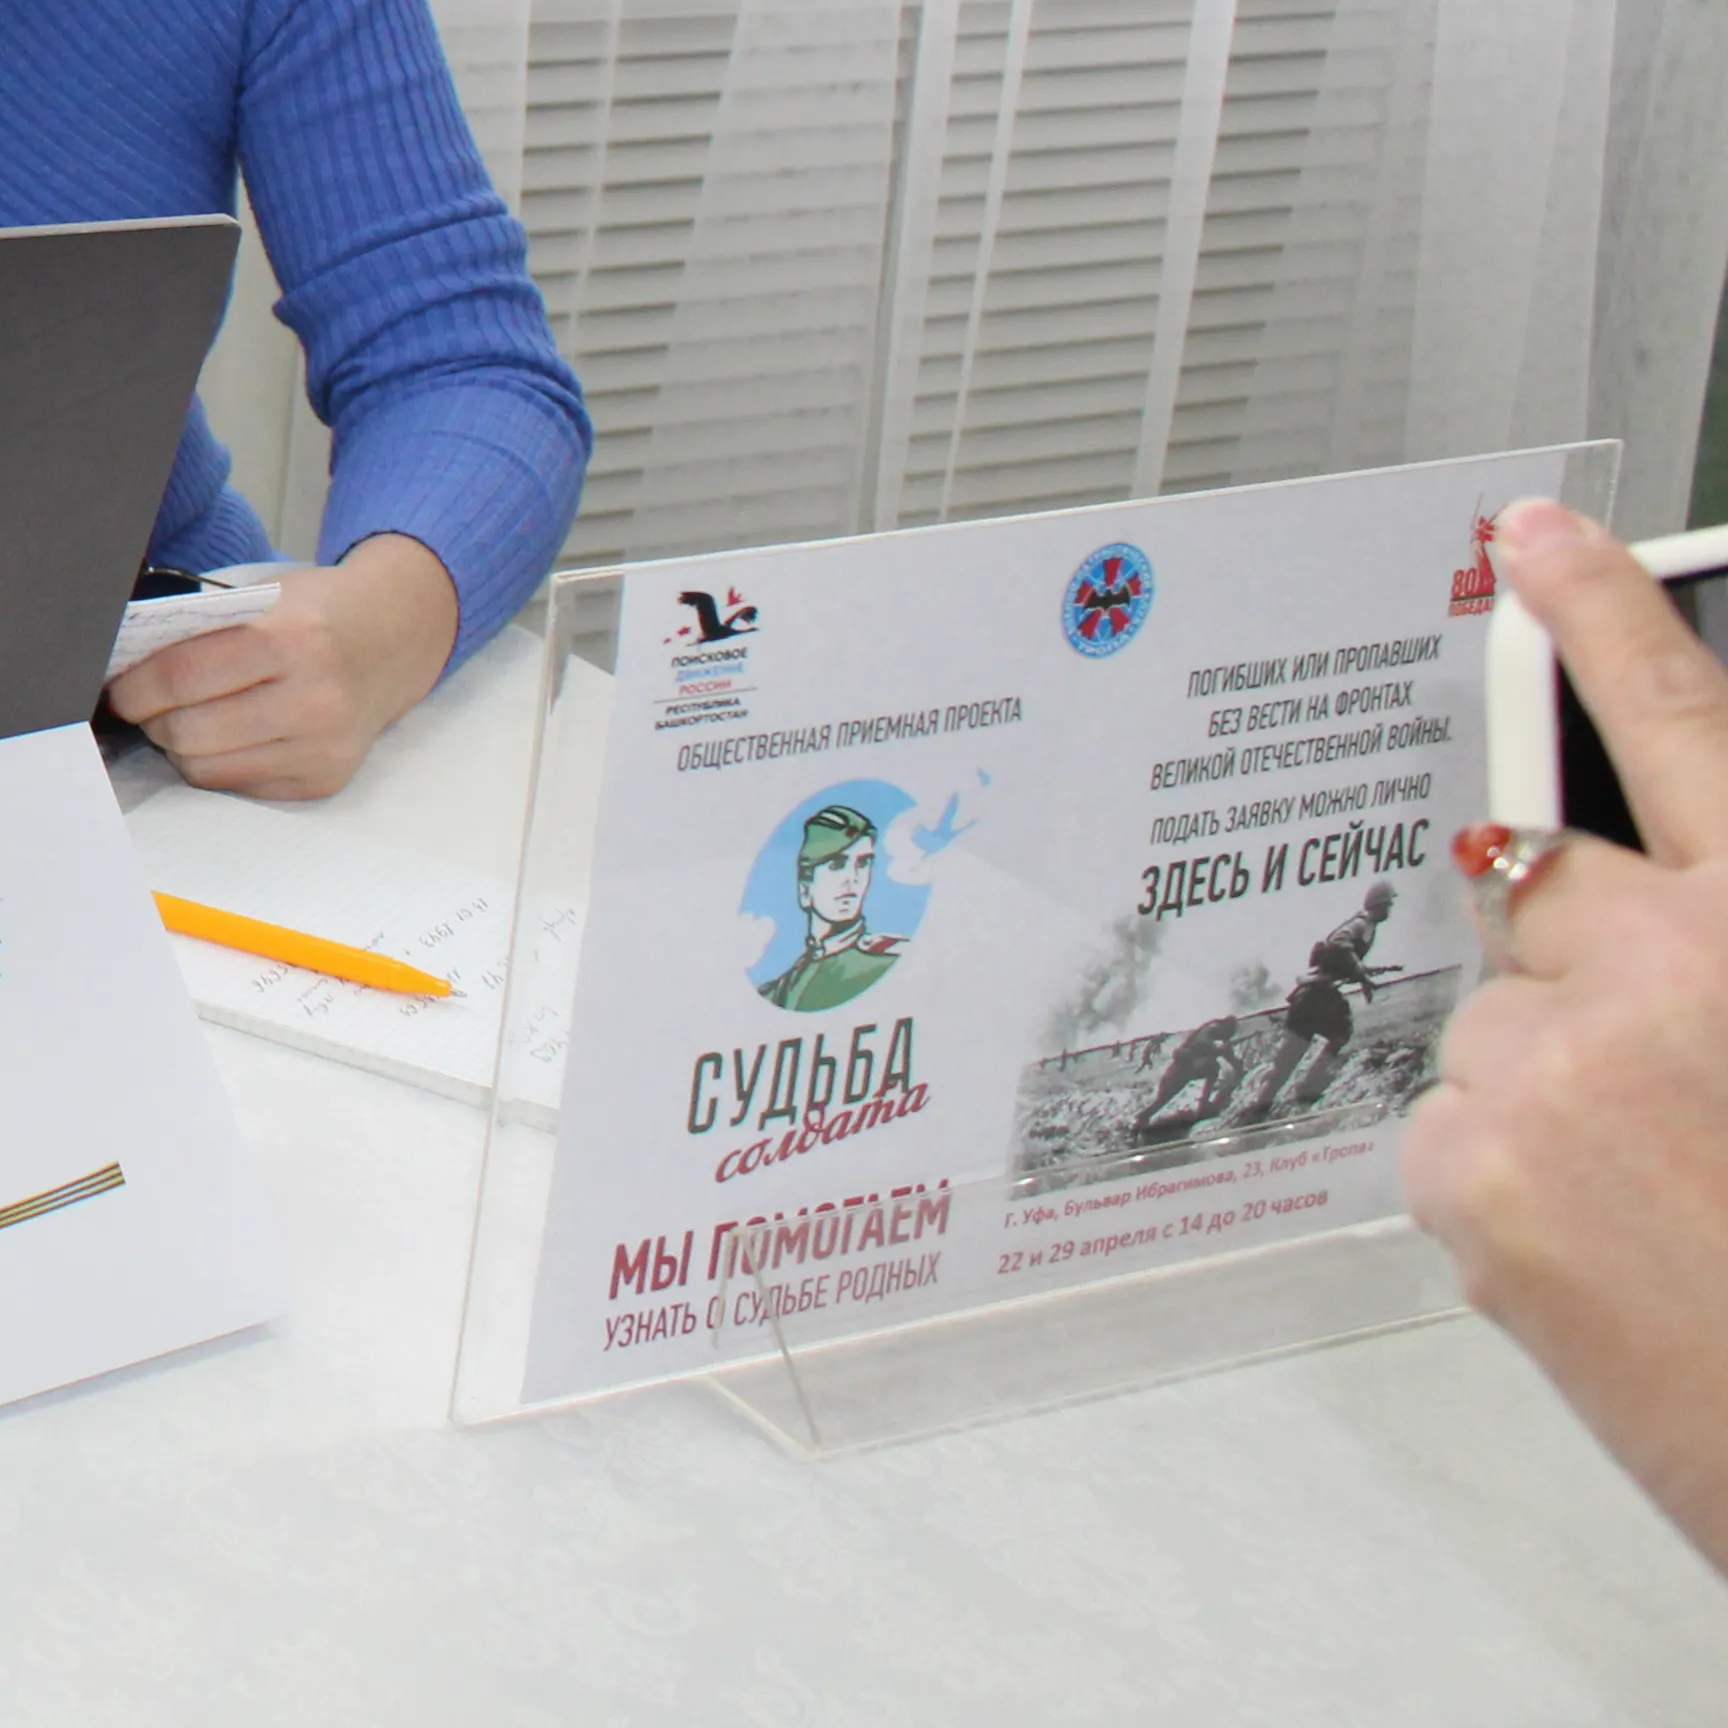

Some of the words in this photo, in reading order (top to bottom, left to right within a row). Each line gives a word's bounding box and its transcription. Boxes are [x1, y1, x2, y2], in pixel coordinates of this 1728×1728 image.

[671, 646, 747, 668] ПОИСКОВОЕ
[679, 680, 731, 695] РОССИИ
[1187, 657, 1287, 699] ПОГИБШИХ
[1292, 650, 1329, 682] ИЛИ
[1333, 634, 1443, 675] ПРОПАВШИХ
[655, 709, 748, 731] БАШКОРТОСТАН
[665, 697, 741, 715] РЕСПУБЛИКА
[677, 725, 831, 772] ОБЩЕСТВЕННАЯ
[836, 709, 940, 747] ПРИЕМНАЯ
[944, 696, 1023, 732] ПРОЕКТА
[1208, 707, 1242, 738] БЕЗ
[1247, 698, 1301, 732] ВЕСТИ
[1306, 693, 1329, 722] НА
[1335, 680, 1415, 717] ФРОНТАХ
[1150, 746, 1235, 791] ВЕЛИКОЙ
[1239, 722, 1383, 775] ОТЕЧЕСТВЕННОЙ
[1387, 716, 1452, 751] ВОЙНЫ.
[1150, 810, 1220, 845] ПОДАТЬ
[1224, 795, 1296, 835] ЗАЯВКУ
[1298, 783, 1369, 822] МОЖНО
[1370, 772, 1432, 808] ЛИЧНО
[1137, 850, 1250, 922] ЗДЕСЬ
[1261, 842, 1289, 894] И
[1297, 818, 1431, 887] СЕЙЧАС
[687, 1016, 914, 1135] СУДЬБА
[714, 1082, 931, 1184] солдата
[1022, 1206, 1059, 1225] Уфа,
[1063, 1190, 1132, 1218] Бульвар
[1269, 1150, 1308, 1172] Клуб
[608, 1230, 695, 1301] МЫ
[706, 1178, 954, 1281] ПОМОГАЕМ
[997, 1251, 1024, 1275] 22
[1029, 1250, 1043, 1267] и
[1048, 1240, 1076, 1264] 29
[1080, 1226, 1157, 1257] апреля
[1162, 1222, 1174, 1239] с
[1178, 1211, 1203, 1236] 14
[1207, 1210, 1236, 1233] до
[1242, 1199, 1267, 1222] 20
[1270, 1190, 1329, 1214] часов
[603, 1301, 697, 1352] УЗНАТЬ
[706, 1295, 725, 1330] О
[734, 1274, 833, 1328] СУДЬБЕ
[835, 1250, 942, 1305] РОДНЫХ
